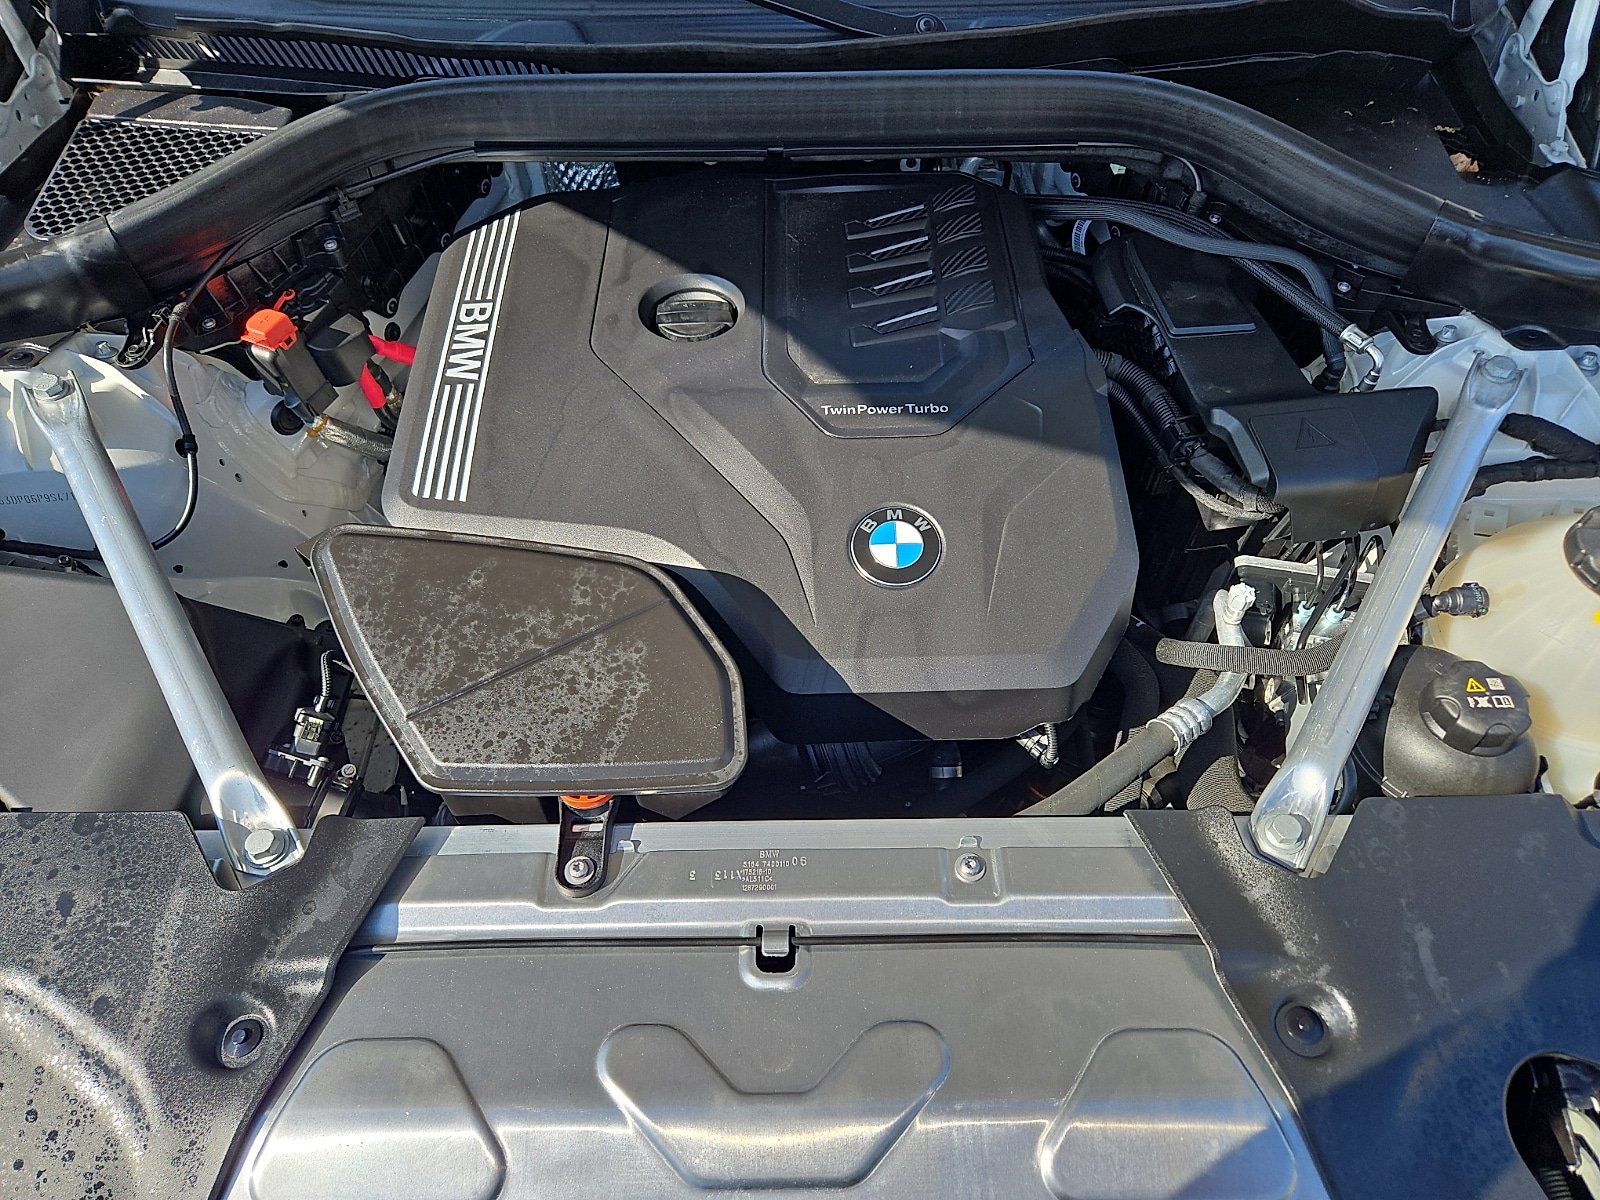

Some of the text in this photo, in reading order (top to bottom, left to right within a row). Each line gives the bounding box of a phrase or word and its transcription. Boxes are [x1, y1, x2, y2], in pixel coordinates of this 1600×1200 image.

[444, 302, 493, 380] BMW
[820, 403, 949, 415] TwinPower Turbo
[860, 509, 932, 534] BMW
[759, 850, 780, 858] BMW
